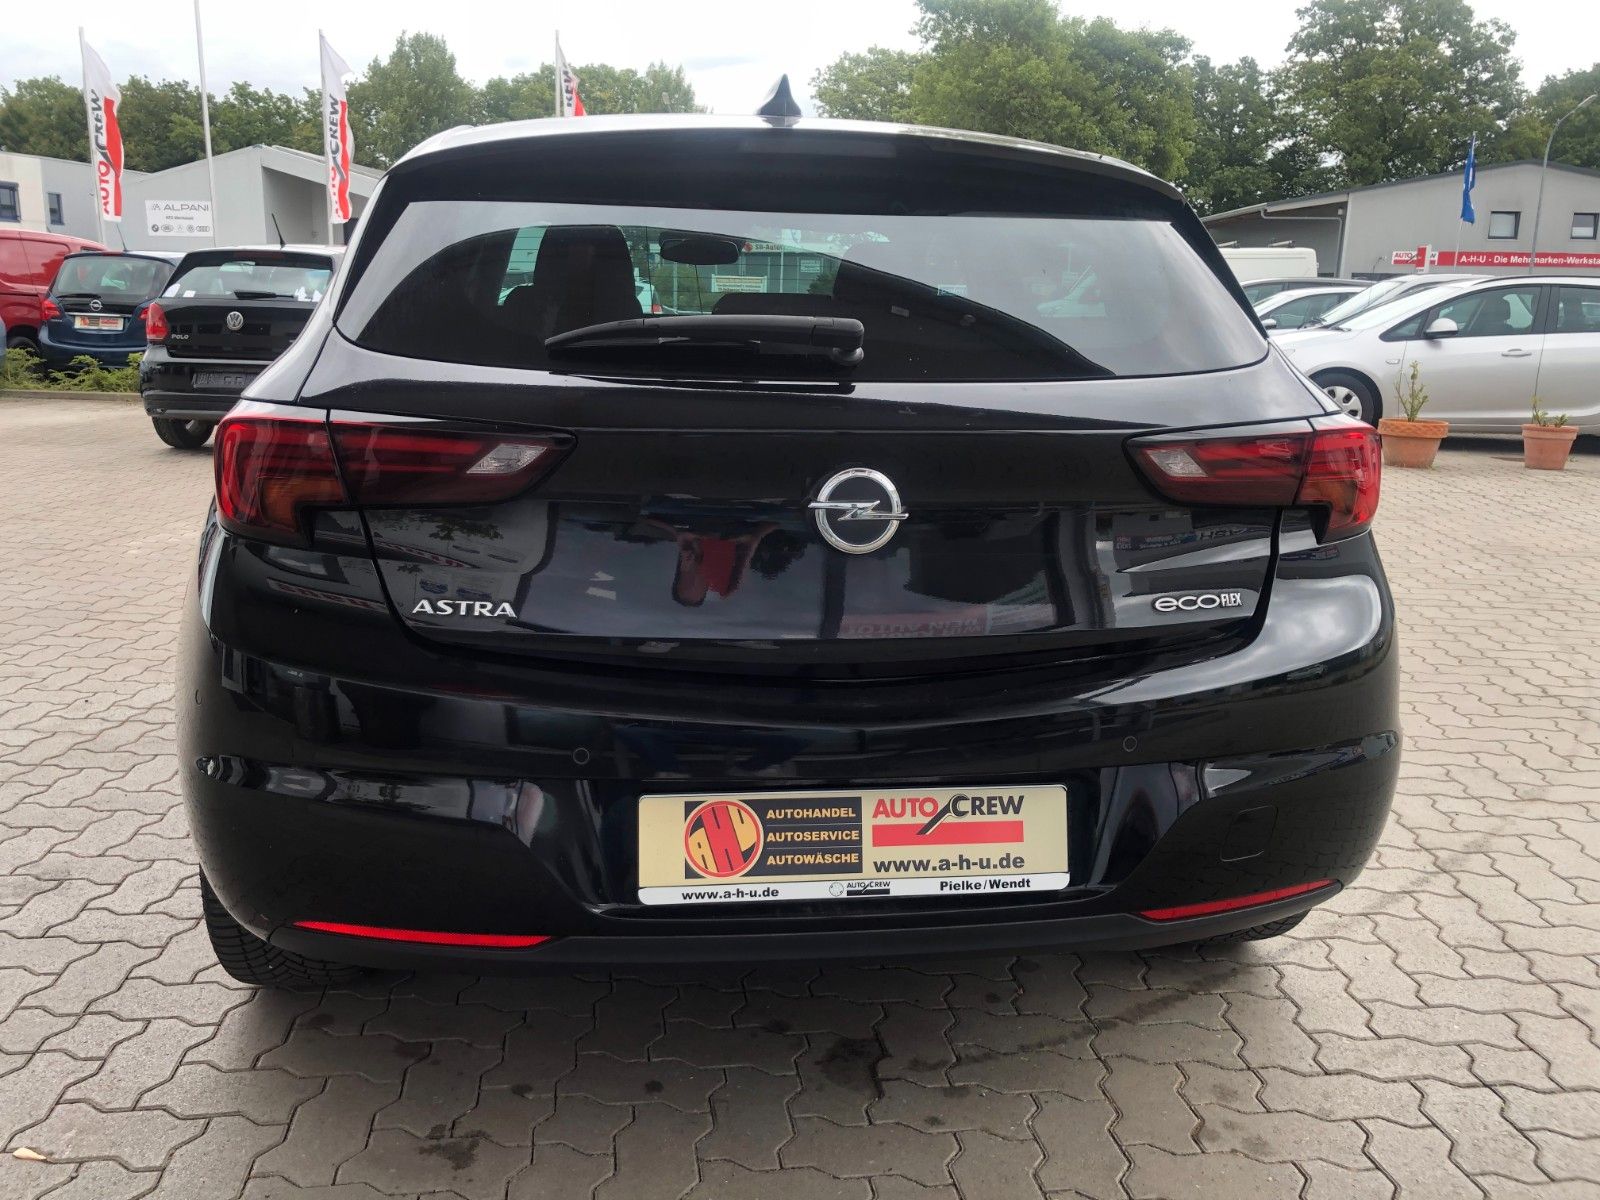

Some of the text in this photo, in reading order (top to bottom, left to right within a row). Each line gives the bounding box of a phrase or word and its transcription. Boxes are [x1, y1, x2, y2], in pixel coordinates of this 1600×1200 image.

[329, 94, 340, 156] CREW
[163, 203, 209, 212] ALPANI
[1460, 255, 1486, 263] A-H-U
[1494, 255, 1508, 263] Die
[412, 599, 518, 618] ASTRA
[766, 807, 856, 820] AUTOHANDEL
[872, 794, 1025, 819] AUTO CREW
[766, 830, 860, 843] AUTOSERVICE
[766, 852, 860, 866] AUTOWÄSCHE
[873, 852, 1025, 873] www.a-h-u.de
[869, 880, 891, 888] CREW
[682, 886, 780, 900] www.a-h-u.de
